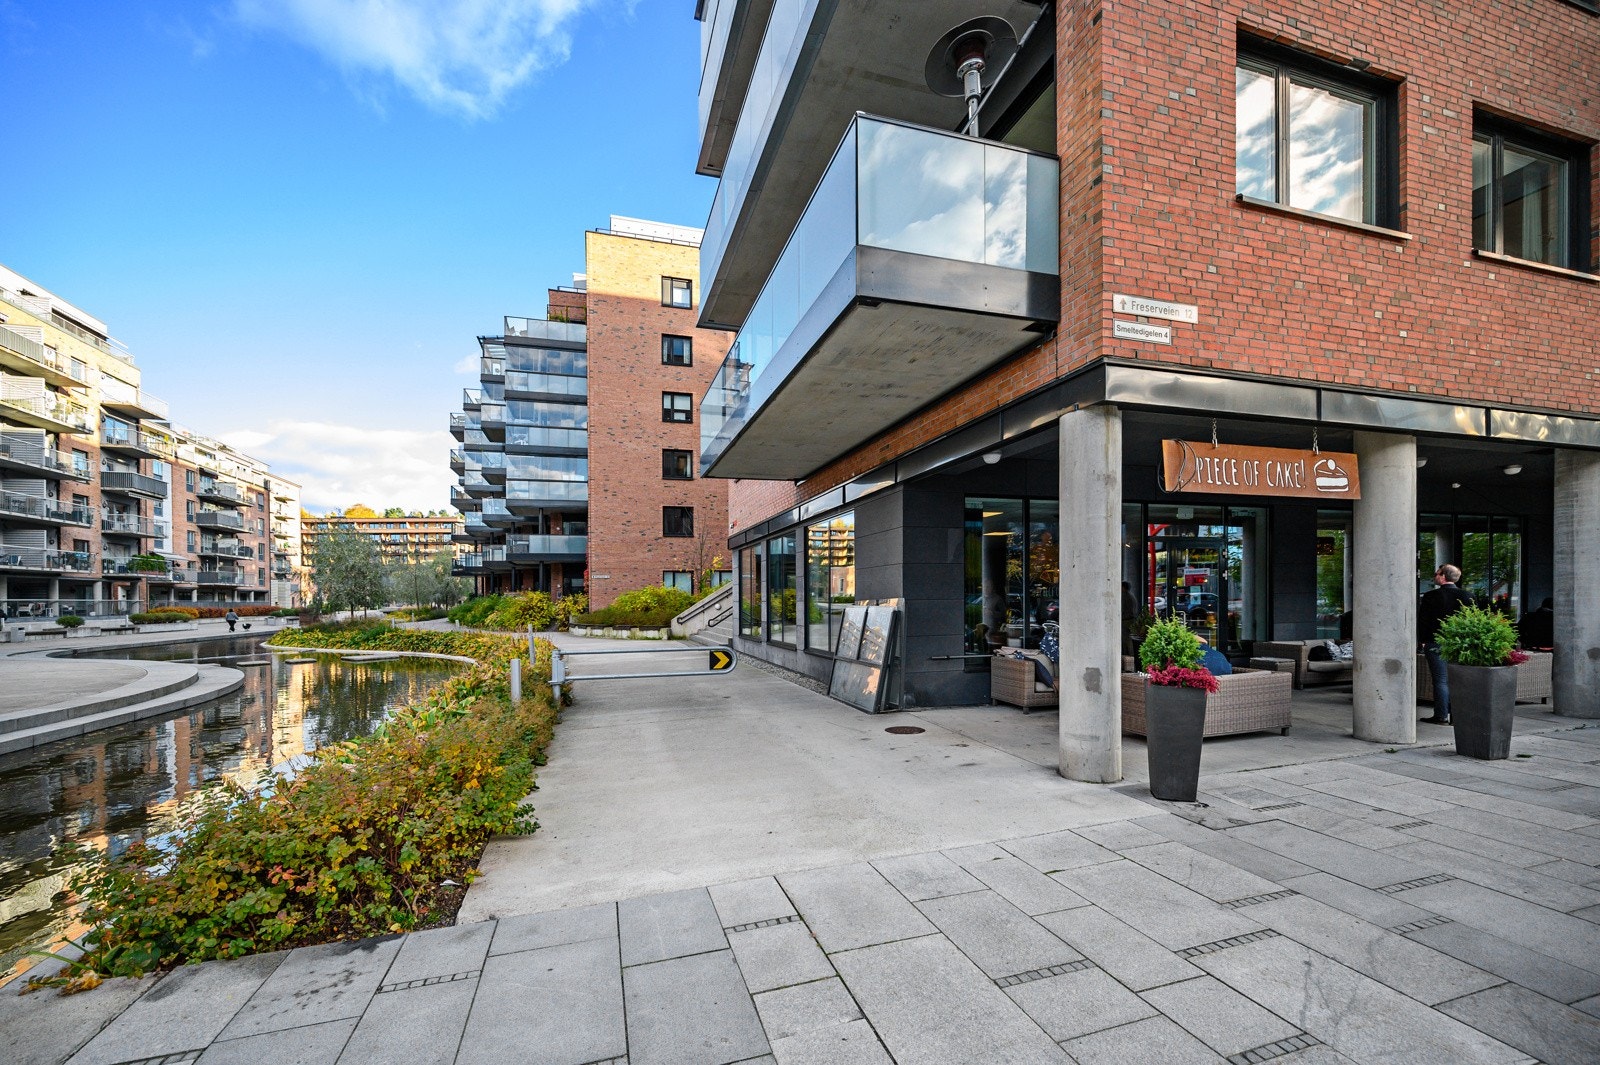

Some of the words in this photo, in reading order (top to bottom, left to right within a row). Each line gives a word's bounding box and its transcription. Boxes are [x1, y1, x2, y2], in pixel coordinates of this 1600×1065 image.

[1131, 301, 1180, 317] Freserveien
[1185, 309, 1193, 319] 12
[1115, 324, 1162, 338] Smeltedigelen
[1163, 331, 1169, 339] 4
[1242, 460, 1260, 486] OF
[1265, 459, 1306, 489] CAKE!
